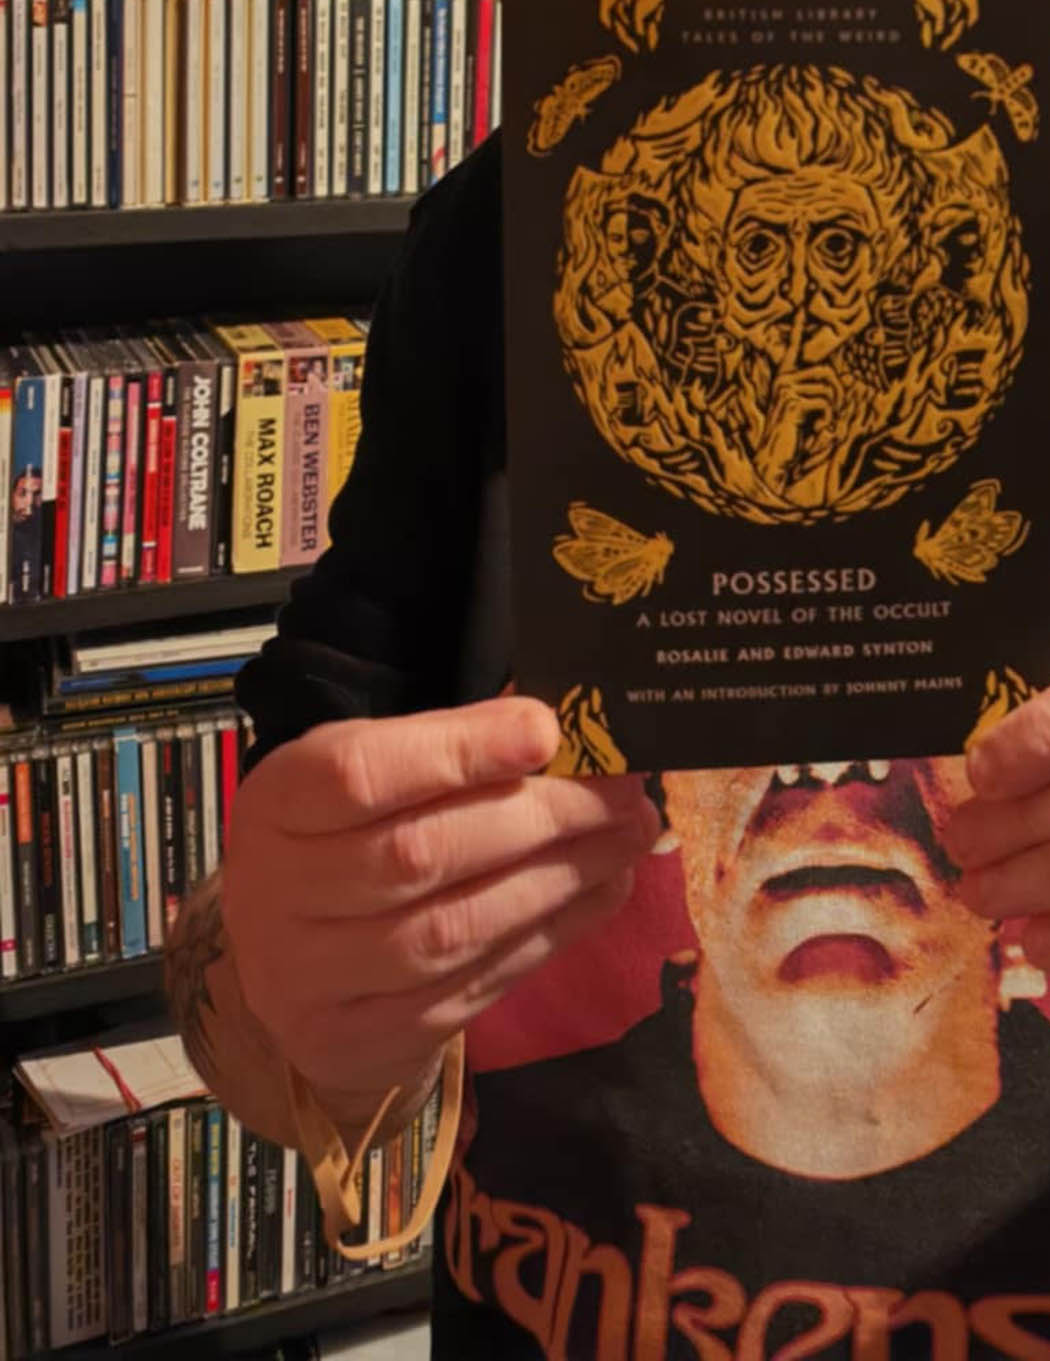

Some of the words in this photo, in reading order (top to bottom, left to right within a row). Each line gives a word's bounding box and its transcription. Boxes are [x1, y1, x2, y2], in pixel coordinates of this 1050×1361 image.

[703, 8, 784, 22] BRITISH
[796, 8, 878, 22] LIBRARY
[681, 30, 738, 44] TALES
[750, 30, 775, 44] OF
[789, 30, 824, 44] THE
[192, 374, 214, 430] JOHN
[302, 403, 321, 444] BEN
[257, 417, 278, 467] MAX
[187, 430, 212, 532] COLTRANE
[254, 474, 277, 550] ROACH
[300, 447, 321, 553] WEBSTER
[712, 567, 877, 596] POSSESSED
[636, 612, 650, 628] A
[660, 610, 708, 628] LOST
[717, 608, 782, 626] NOVEL
[791, 607, 817, 623] OF
[828, 605, 864, 622] THE
[873, 600, 952, 620] OCCULT
[656, 647, 729, 664] ROSALIE
[737, 646, 775, 661] AND
[783, 643, 855, 659] EDWARD
[862, 640, 934, 657] SYNTON
[626, 689, 666, 703] WITH
[671, 688, 696, 702] AN
[702, 684, 817, 701] INTRODUCTION
[822, 682, 841, 696] BY
[846, 680, 908, 695] JOHNNY
[914, 676, 964, 691] MAINS
